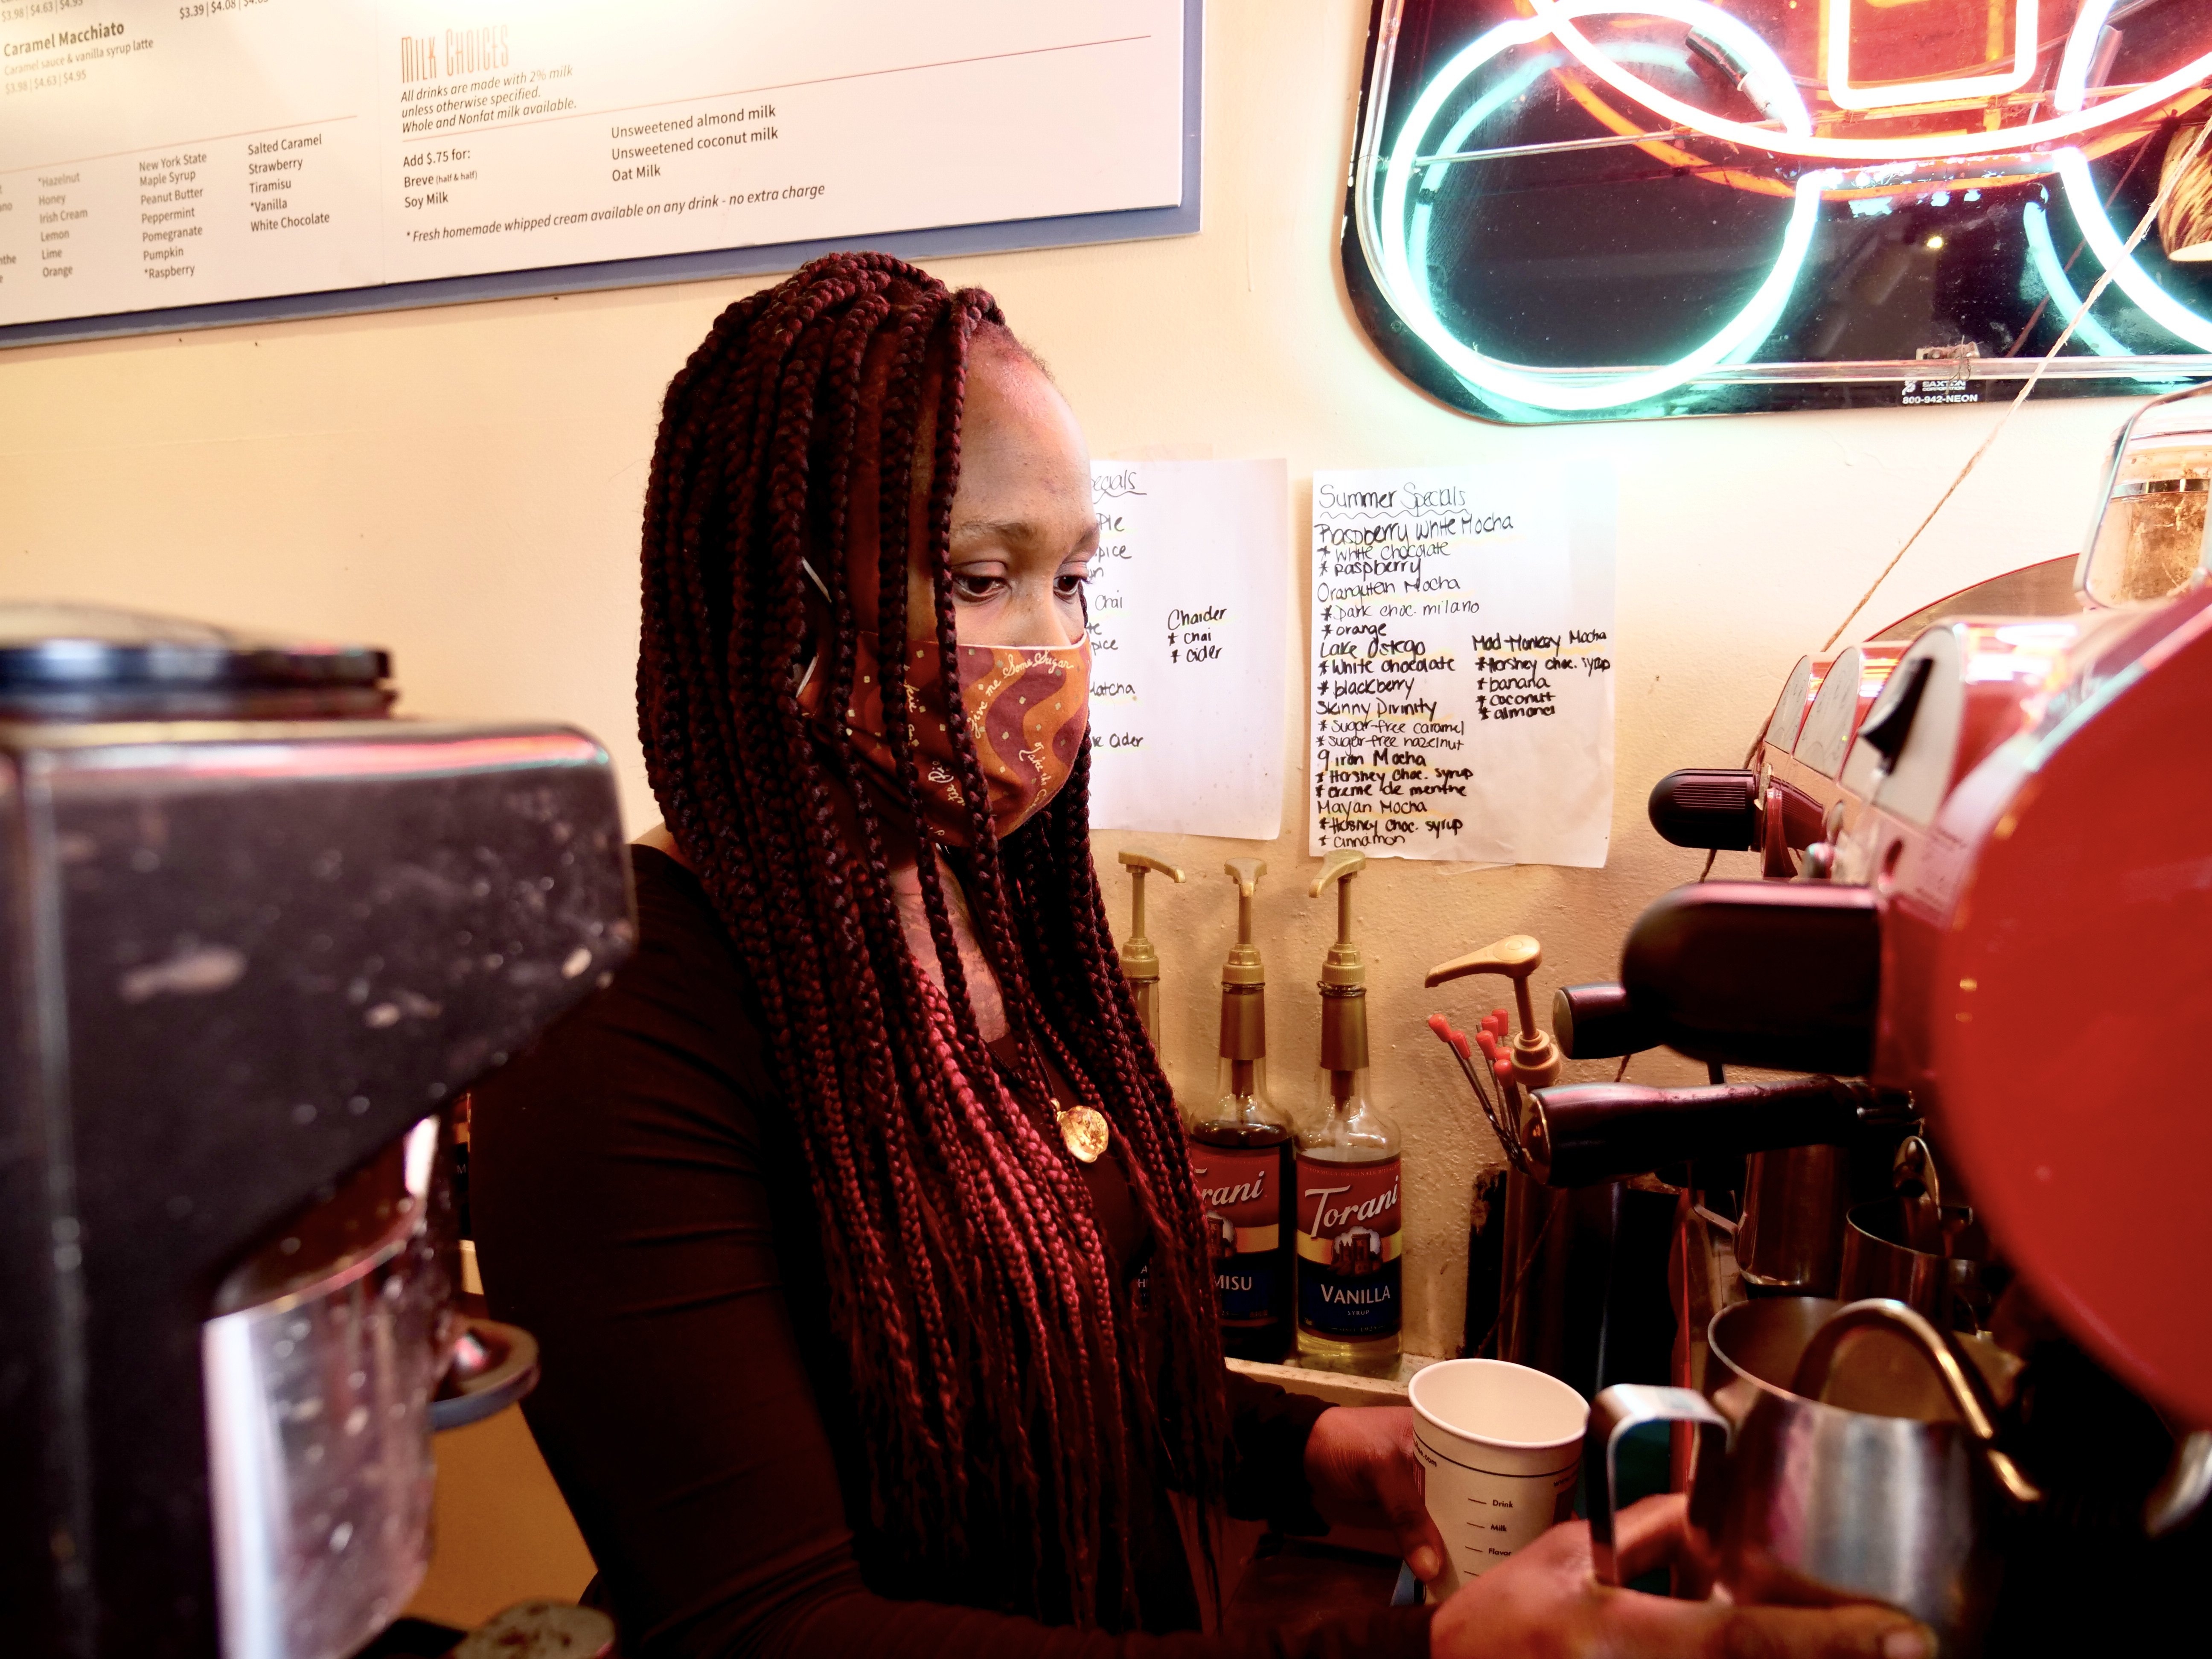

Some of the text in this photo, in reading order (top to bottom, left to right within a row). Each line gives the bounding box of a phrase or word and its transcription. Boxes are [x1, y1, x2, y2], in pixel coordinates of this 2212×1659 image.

[30, 1, 53, 16] $4.63
[180, 4, 204, 20] $3.39
[4, 22, 124, 56] Caramel Macchiato
[5, 39, 154, 76] Caramel sauce & vanilla syrup latte
[35, 75, 57, 89] $4.63
[64, 70, 86, 84] $4.95
[401, 64, 573, 103] All drinks are made with 2% milk
[402, 86, 541, 118] unless otherwise specified.
[402, 97, 577, 133] Whole and Nonfat milk available.
[611, 105, 776, 139] Unsweetened almond milk
[248, 134, 322, 155] Salted Caramel
[612, 127, 779, 160] Unsweetened coconut milk
[140, 153, 207, 172] New York State
[249, 158, 303, 175] Strawberry
[403, 148, 471, 168] Add $.75 for:
[140, 170, 196, 187] Maple Syrup
[404, 170, 478, 188] Breve (half & half)
[612, 164, 661, 181] Oat Milk
[250, 179, 291, 194] Tiramisu
[39, 195, 65, 205] Honey
[141, 188, 203, 205] Peanut Butter
[405, 192, 448, 210] Soy Milk
[40, 210, 88, 224] Irish Cream
[142, 207, 195, 225] Peppermint
[413, 184, 825, 242] Fresh homemade whipped cream available on any drink no extra charge
[251, 213, 330, 233] White Chocolate
[41, 230, 69, 242] Lemon
[143, 226, 202, 242] Pomegranate
[42, 249, 62, 259] Lime
[144, 246, 183, 262] Pumpkin
[43, 266, 73, 278] Orange
[1902, 394, 1978, 405] 800-942-NEON
[1319, 483, 1465, 517] Summer Specials
[1314, 522, 1409, 547] Raspberry
[1461, 512, 1513, 535] Mocha
[1096, 545, 1132, 563] pice
[1404, 576, 1461, 593] Mocha
[1167, 605, 1227, 630] Chaider
[1336, 623, 1387, 641] orange
[1472, 632, 1501, 651] Mad
[1569, 629, 1607, 644] Mocha
[1091, 639, 1118, 656] pice
[1320, 640, 1357, 659] Lake
[1489, 677, 1551, 693] banana
[1316, 697, 1437, 722] Skinny Divinity
[1403, 737, 1464, 751] hazelnut
[1373, 748, 1426, 767] Mocha
[1382, 781, 1404, 796] de
[1317, 799, 1427, 819] Mayan Mocha
[1309, 1167, 1338, 1176] FORMULA
[1304, 1174, 1398, 1240] Torani
[1320, 1284, 1391, 1305] VANILLA
[1492, 1499, 1513, 1508] Drink
[1490, 1524, 1507, 1532] Milk
[1488, 1548, 1512, 1557] Flavor
